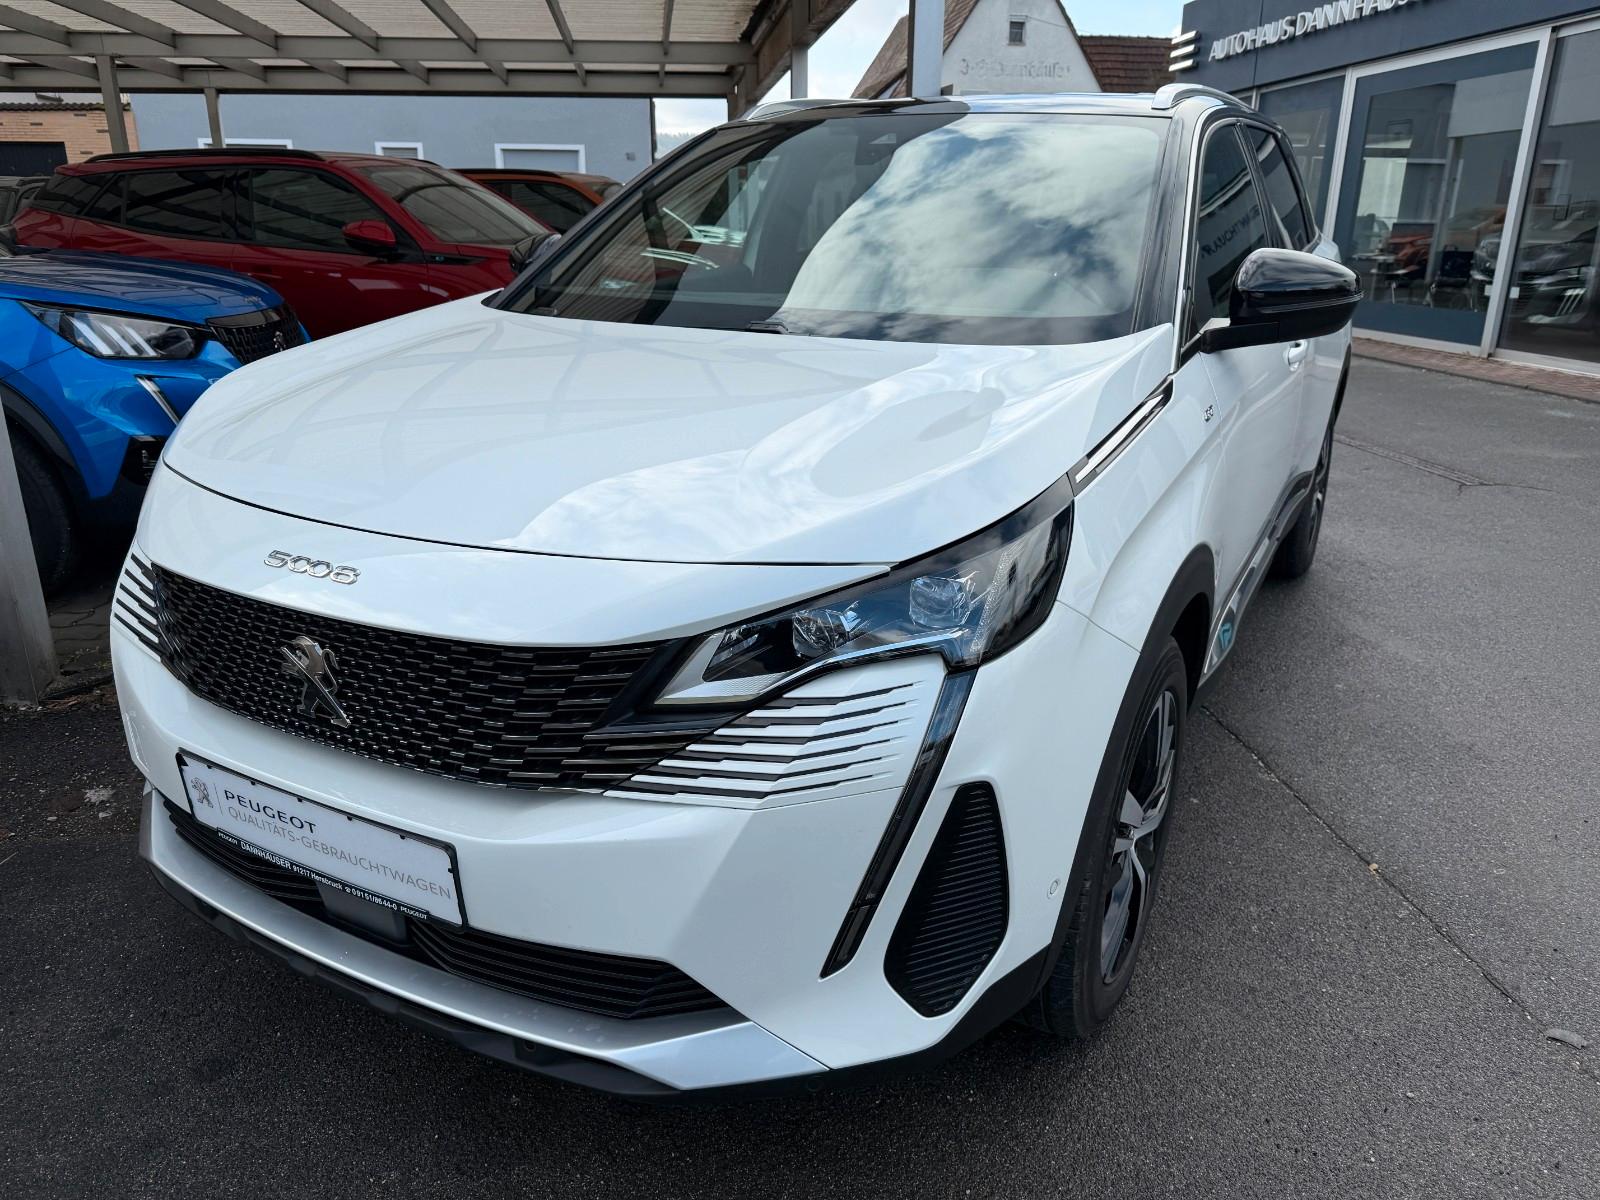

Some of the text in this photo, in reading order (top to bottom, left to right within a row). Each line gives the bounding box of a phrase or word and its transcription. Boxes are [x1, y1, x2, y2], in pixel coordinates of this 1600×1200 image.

[1208, 0, 1409, 62] AUTOHAUS DANNHAU
[263, 549, 361, 585] 5008
[224, 789, 317, 834] PEUGEOT
